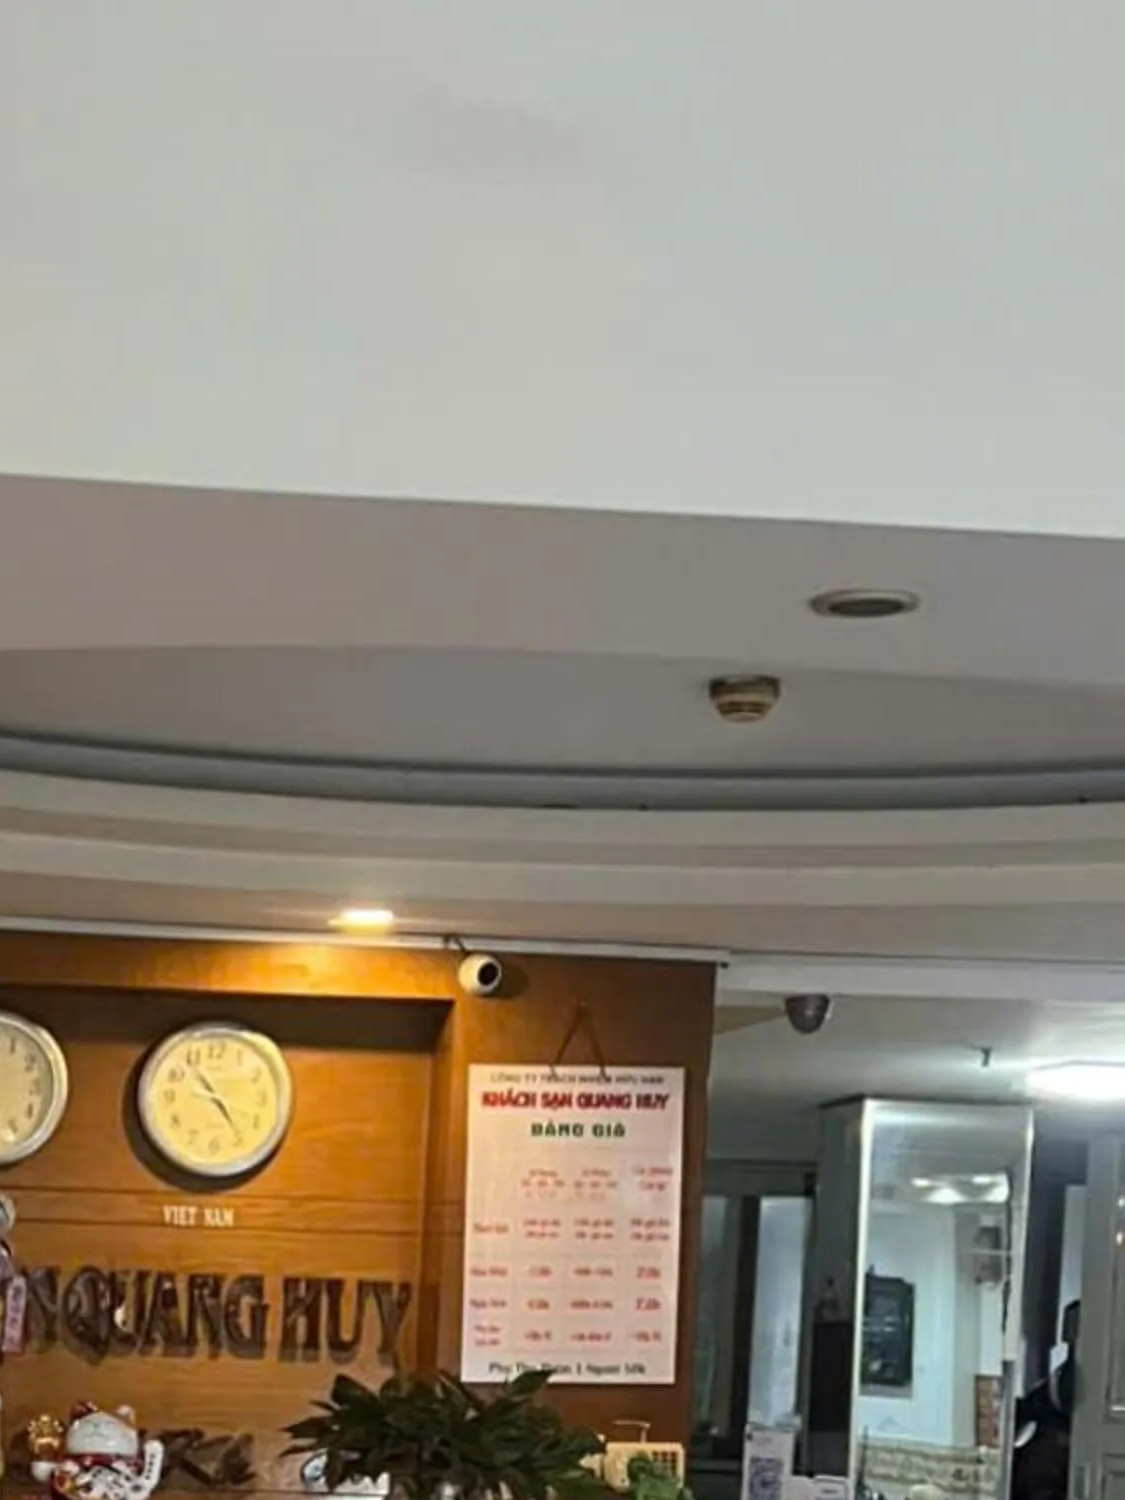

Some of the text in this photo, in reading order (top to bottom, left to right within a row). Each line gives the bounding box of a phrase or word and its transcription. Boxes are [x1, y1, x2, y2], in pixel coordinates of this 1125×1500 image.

[482, 1088, 670, 1112] KHÁCH SẠN QUANG HUY
[163, 1205, 234, 1227] VIET NAM
[63, 1265, 268, 1363] QUANG
[279, 1276, 412, 1364] HUY
